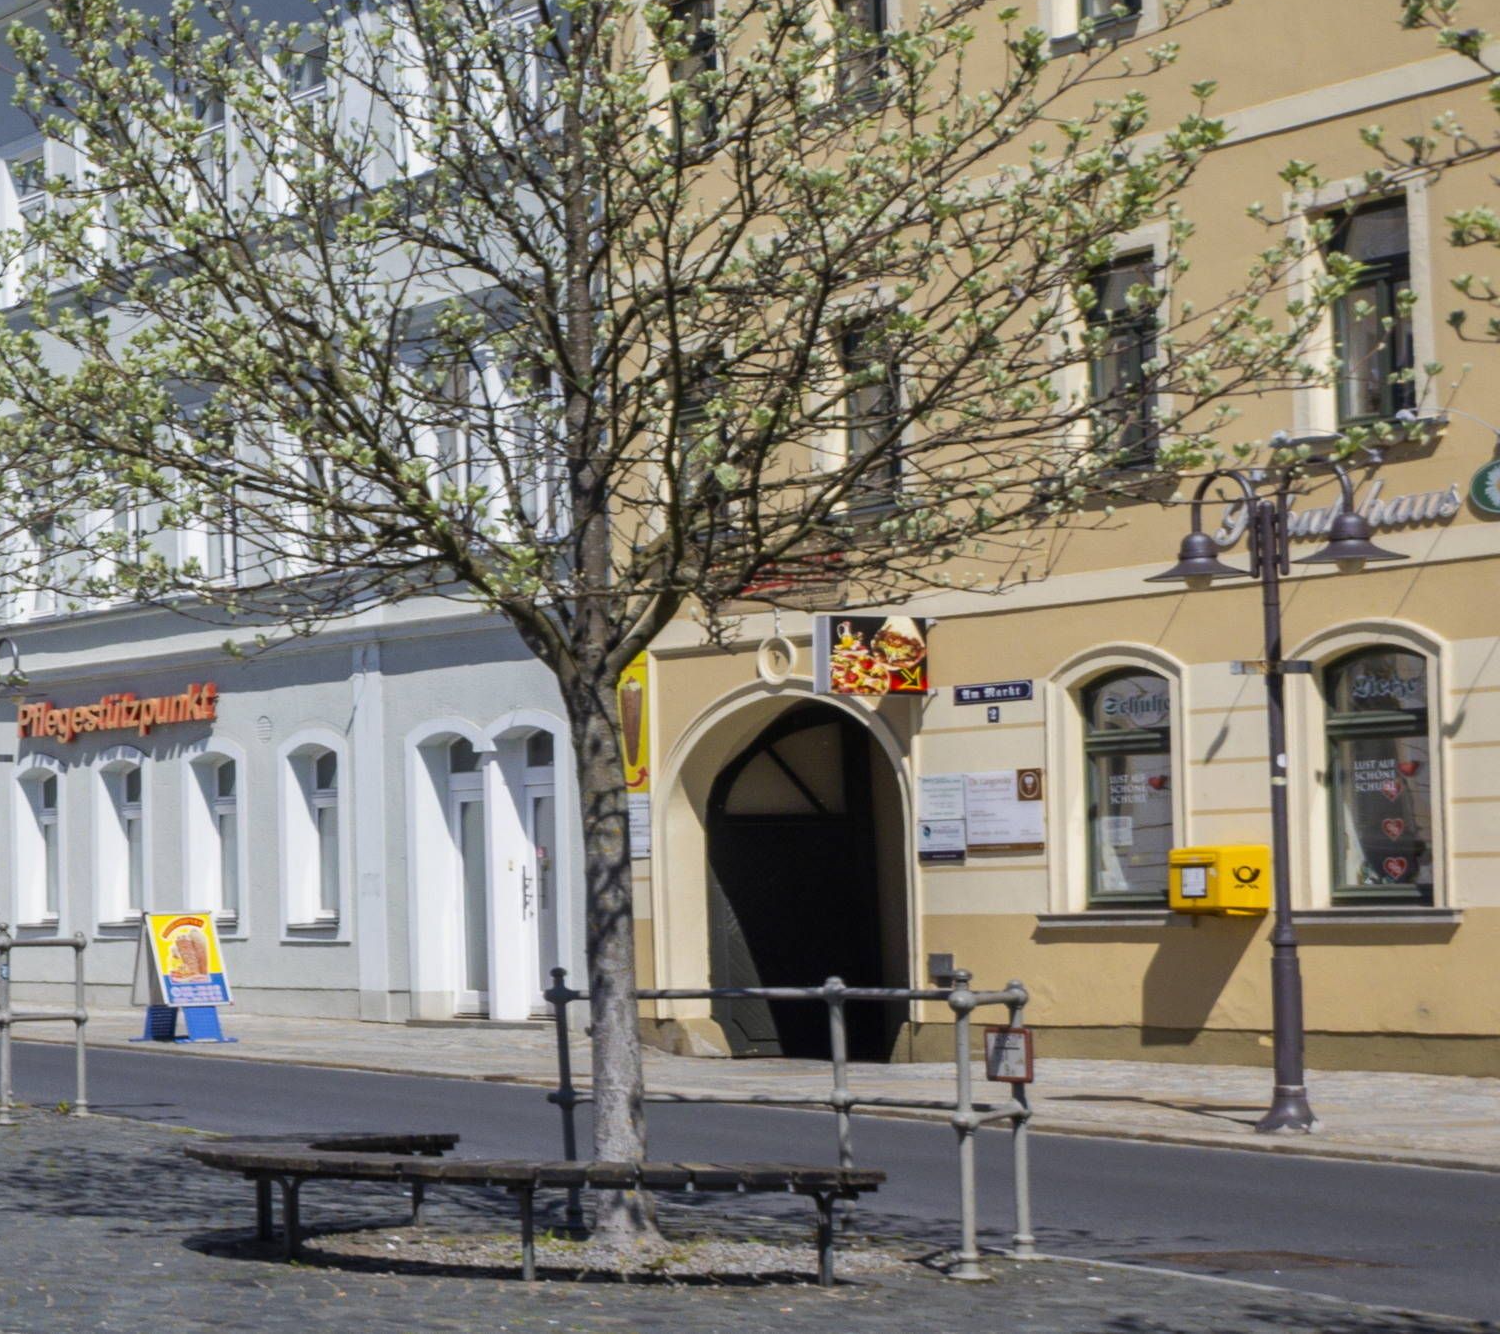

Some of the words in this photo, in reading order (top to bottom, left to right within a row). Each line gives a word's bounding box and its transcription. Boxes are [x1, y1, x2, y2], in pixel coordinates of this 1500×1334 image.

[961, 689, 980, 701] Am
[983, 685, 1021, 699] Markt
[18, 682, 219, 744] Pflegestützpunkt
[988, 707, 998, 721] 2
